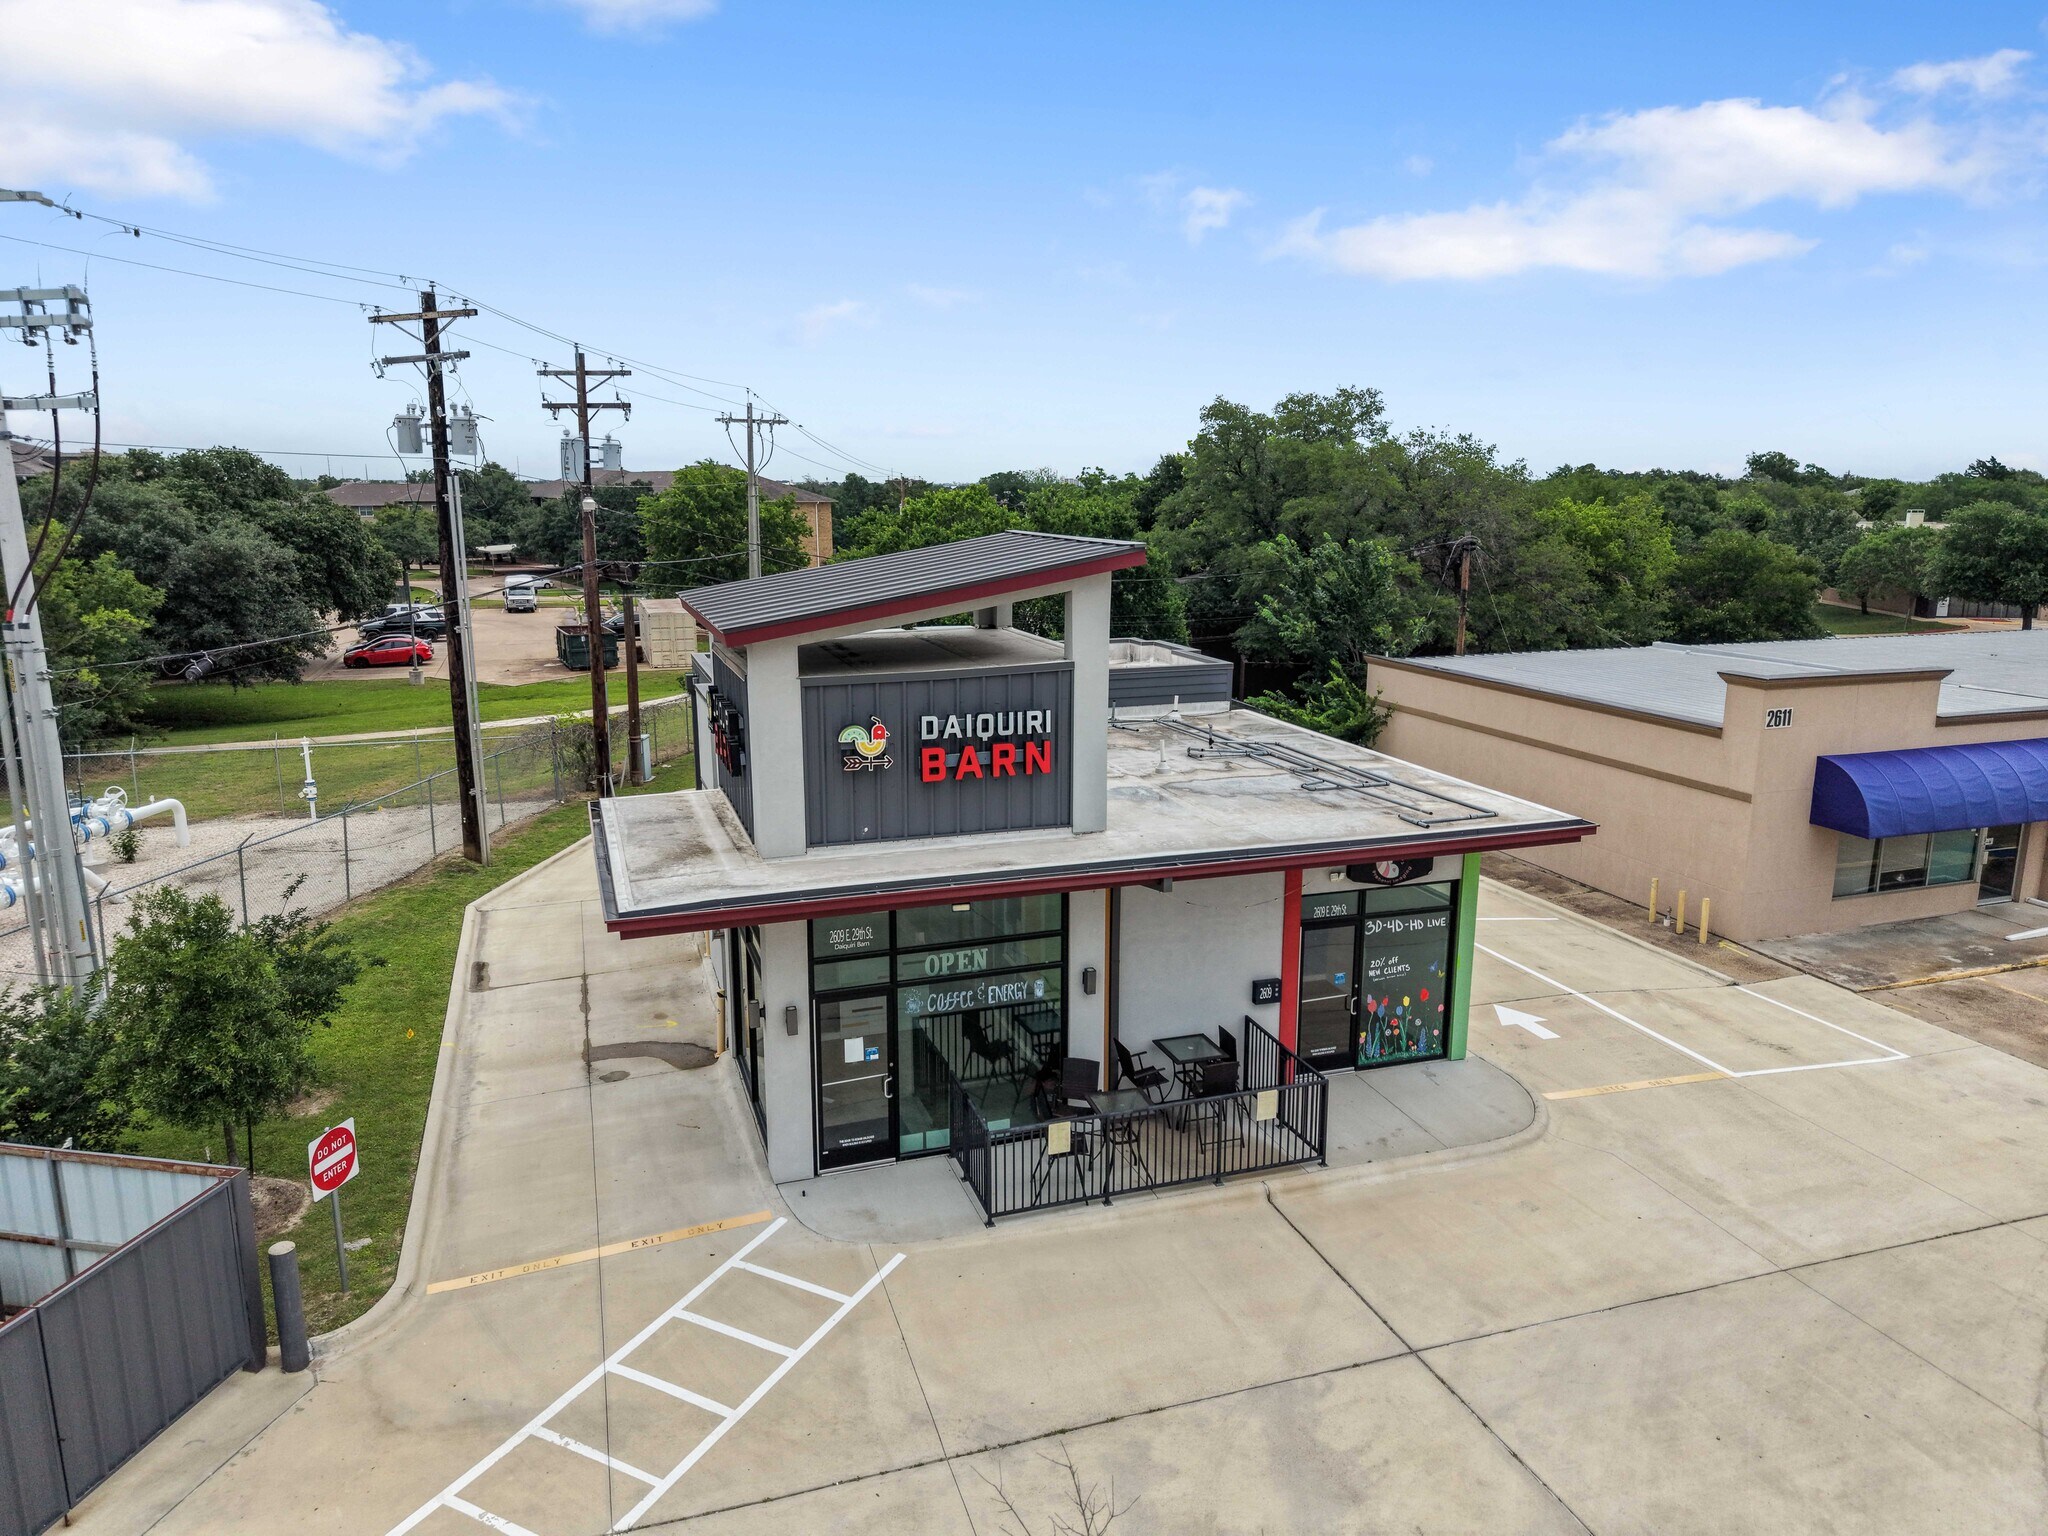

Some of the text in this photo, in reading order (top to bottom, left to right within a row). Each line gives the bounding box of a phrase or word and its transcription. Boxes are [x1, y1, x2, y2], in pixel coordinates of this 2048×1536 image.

[921, 709, 1052, 741] DAIQUIRI
[1766, 709, 1792, 727] 2611
[921, 740, 1052, 783] BARN
[829, 929, 844, 944] 2609
[851, 926, 866, 941] 29th
[1365, 917, 1446, 935] 3D-4D-HD LIVE
[834, 942, 856, 950] Daiquiri
[925, 948, 988, 977] OPEN
[1368, 968, 1381, 978] NEW
[1383, 964, 1411, 975] CLIENTS
[1370, 956, 1399, 968] 20% off
[988, 981, 1028, 1004] ENERGY
[317, 1134, 347, 1160] DO NOT
[323, 1160, 348, 1182] ENTER
[631, 1222, 723, 1248] EXIT ONLY
[470, 1258, 560, 1284] EXIT ONLY
